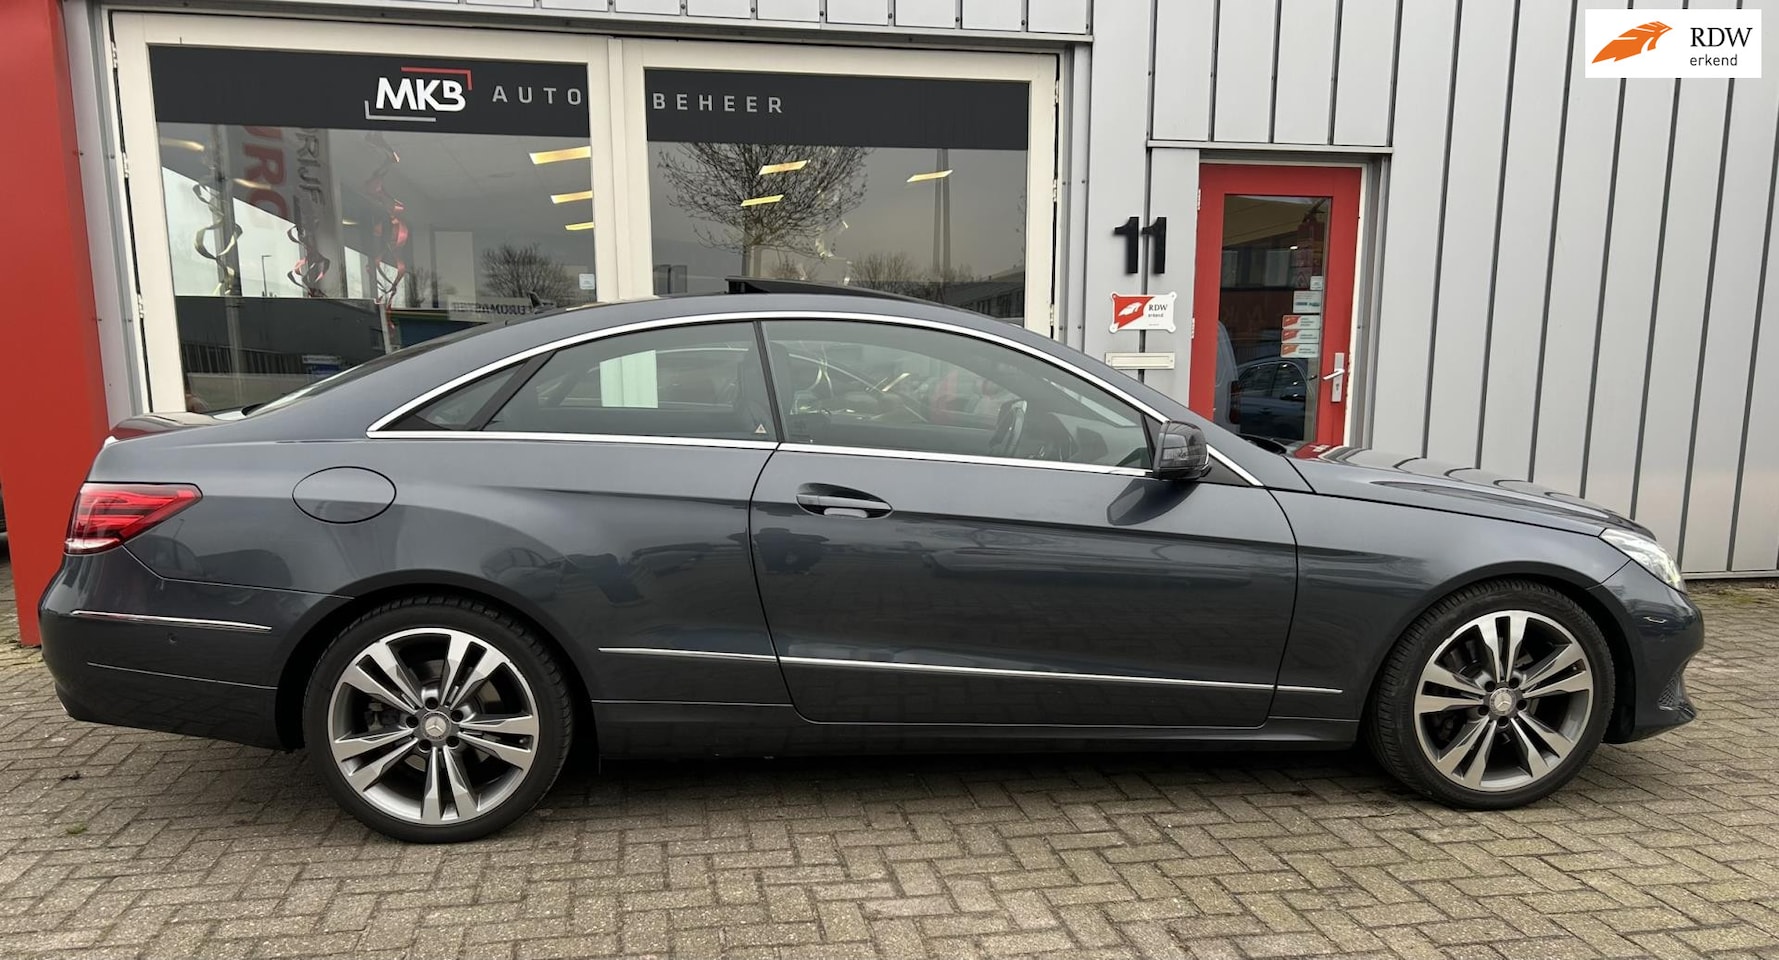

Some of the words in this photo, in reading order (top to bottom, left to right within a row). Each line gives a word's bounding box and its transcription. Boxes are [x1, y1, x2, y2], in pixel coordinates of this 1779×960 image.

[375, 77, 466, 112] MKB
[492, 85, 582, 105] AUTO
[652, 92, 782, 113] BEHEER
[1114, 216, 1167, 274] 11
